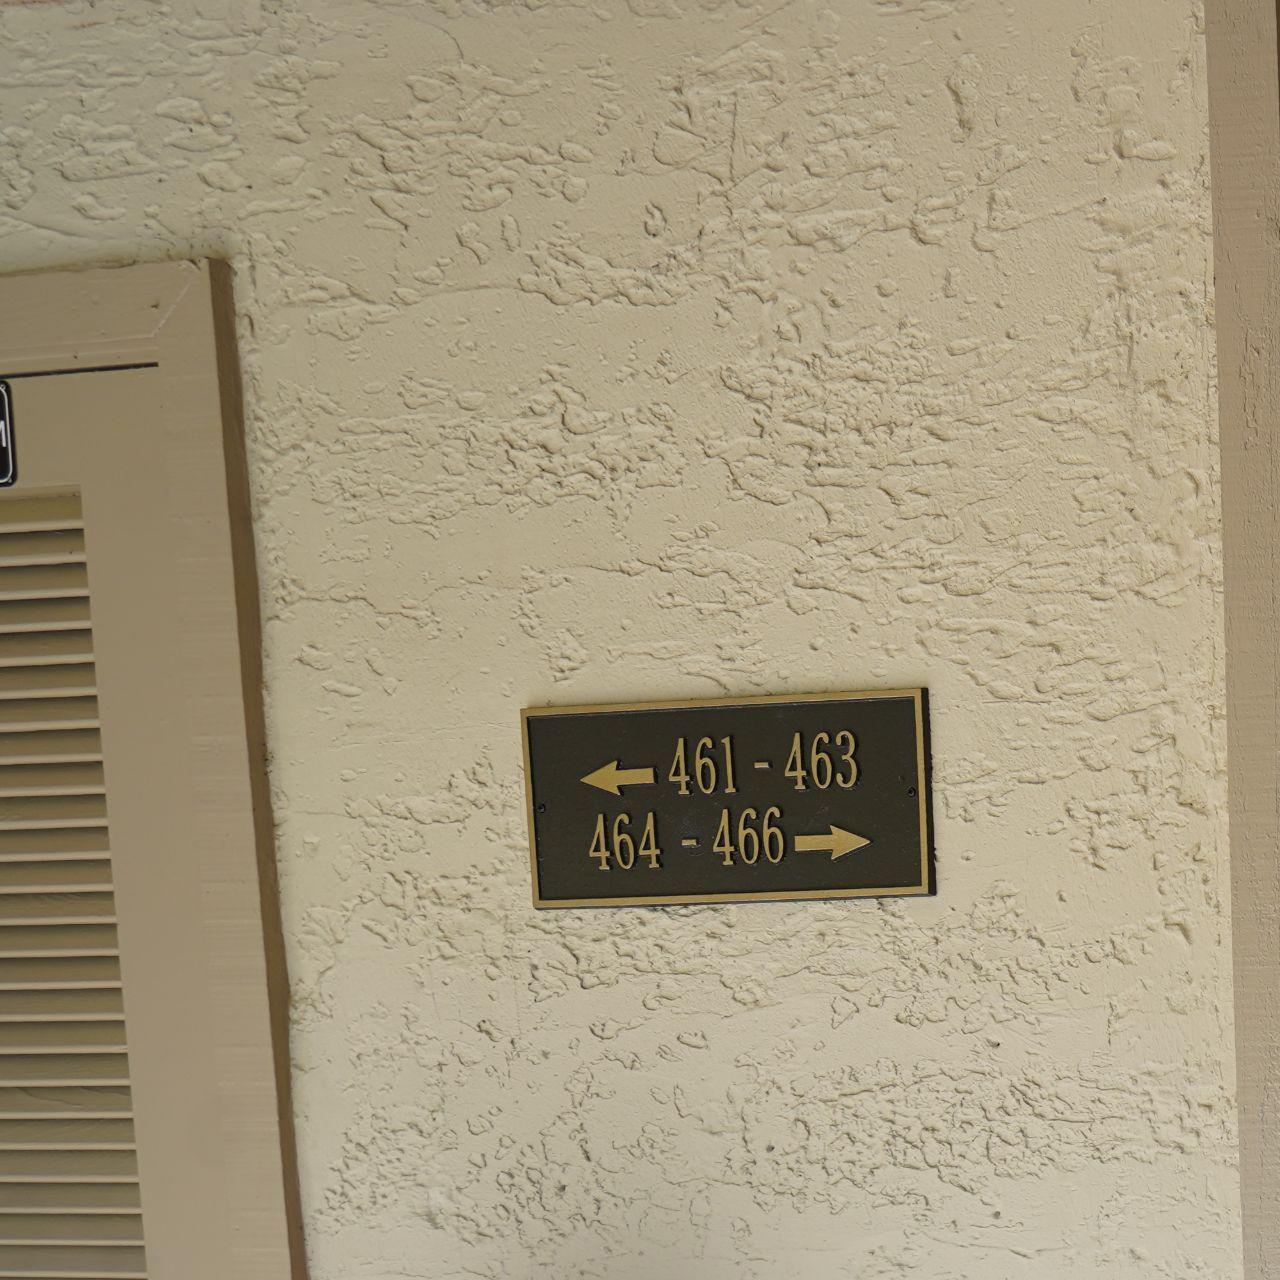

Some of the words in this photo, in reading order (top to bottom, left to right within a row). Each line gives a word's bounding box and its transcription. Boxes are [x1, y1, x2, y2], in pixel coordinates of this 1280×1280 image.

[668, 736, 738, 796] 461
[784, 730, 859, 791] 463
[588, 811, 661, 871] 464
[712, 806, 786, 866] 466
